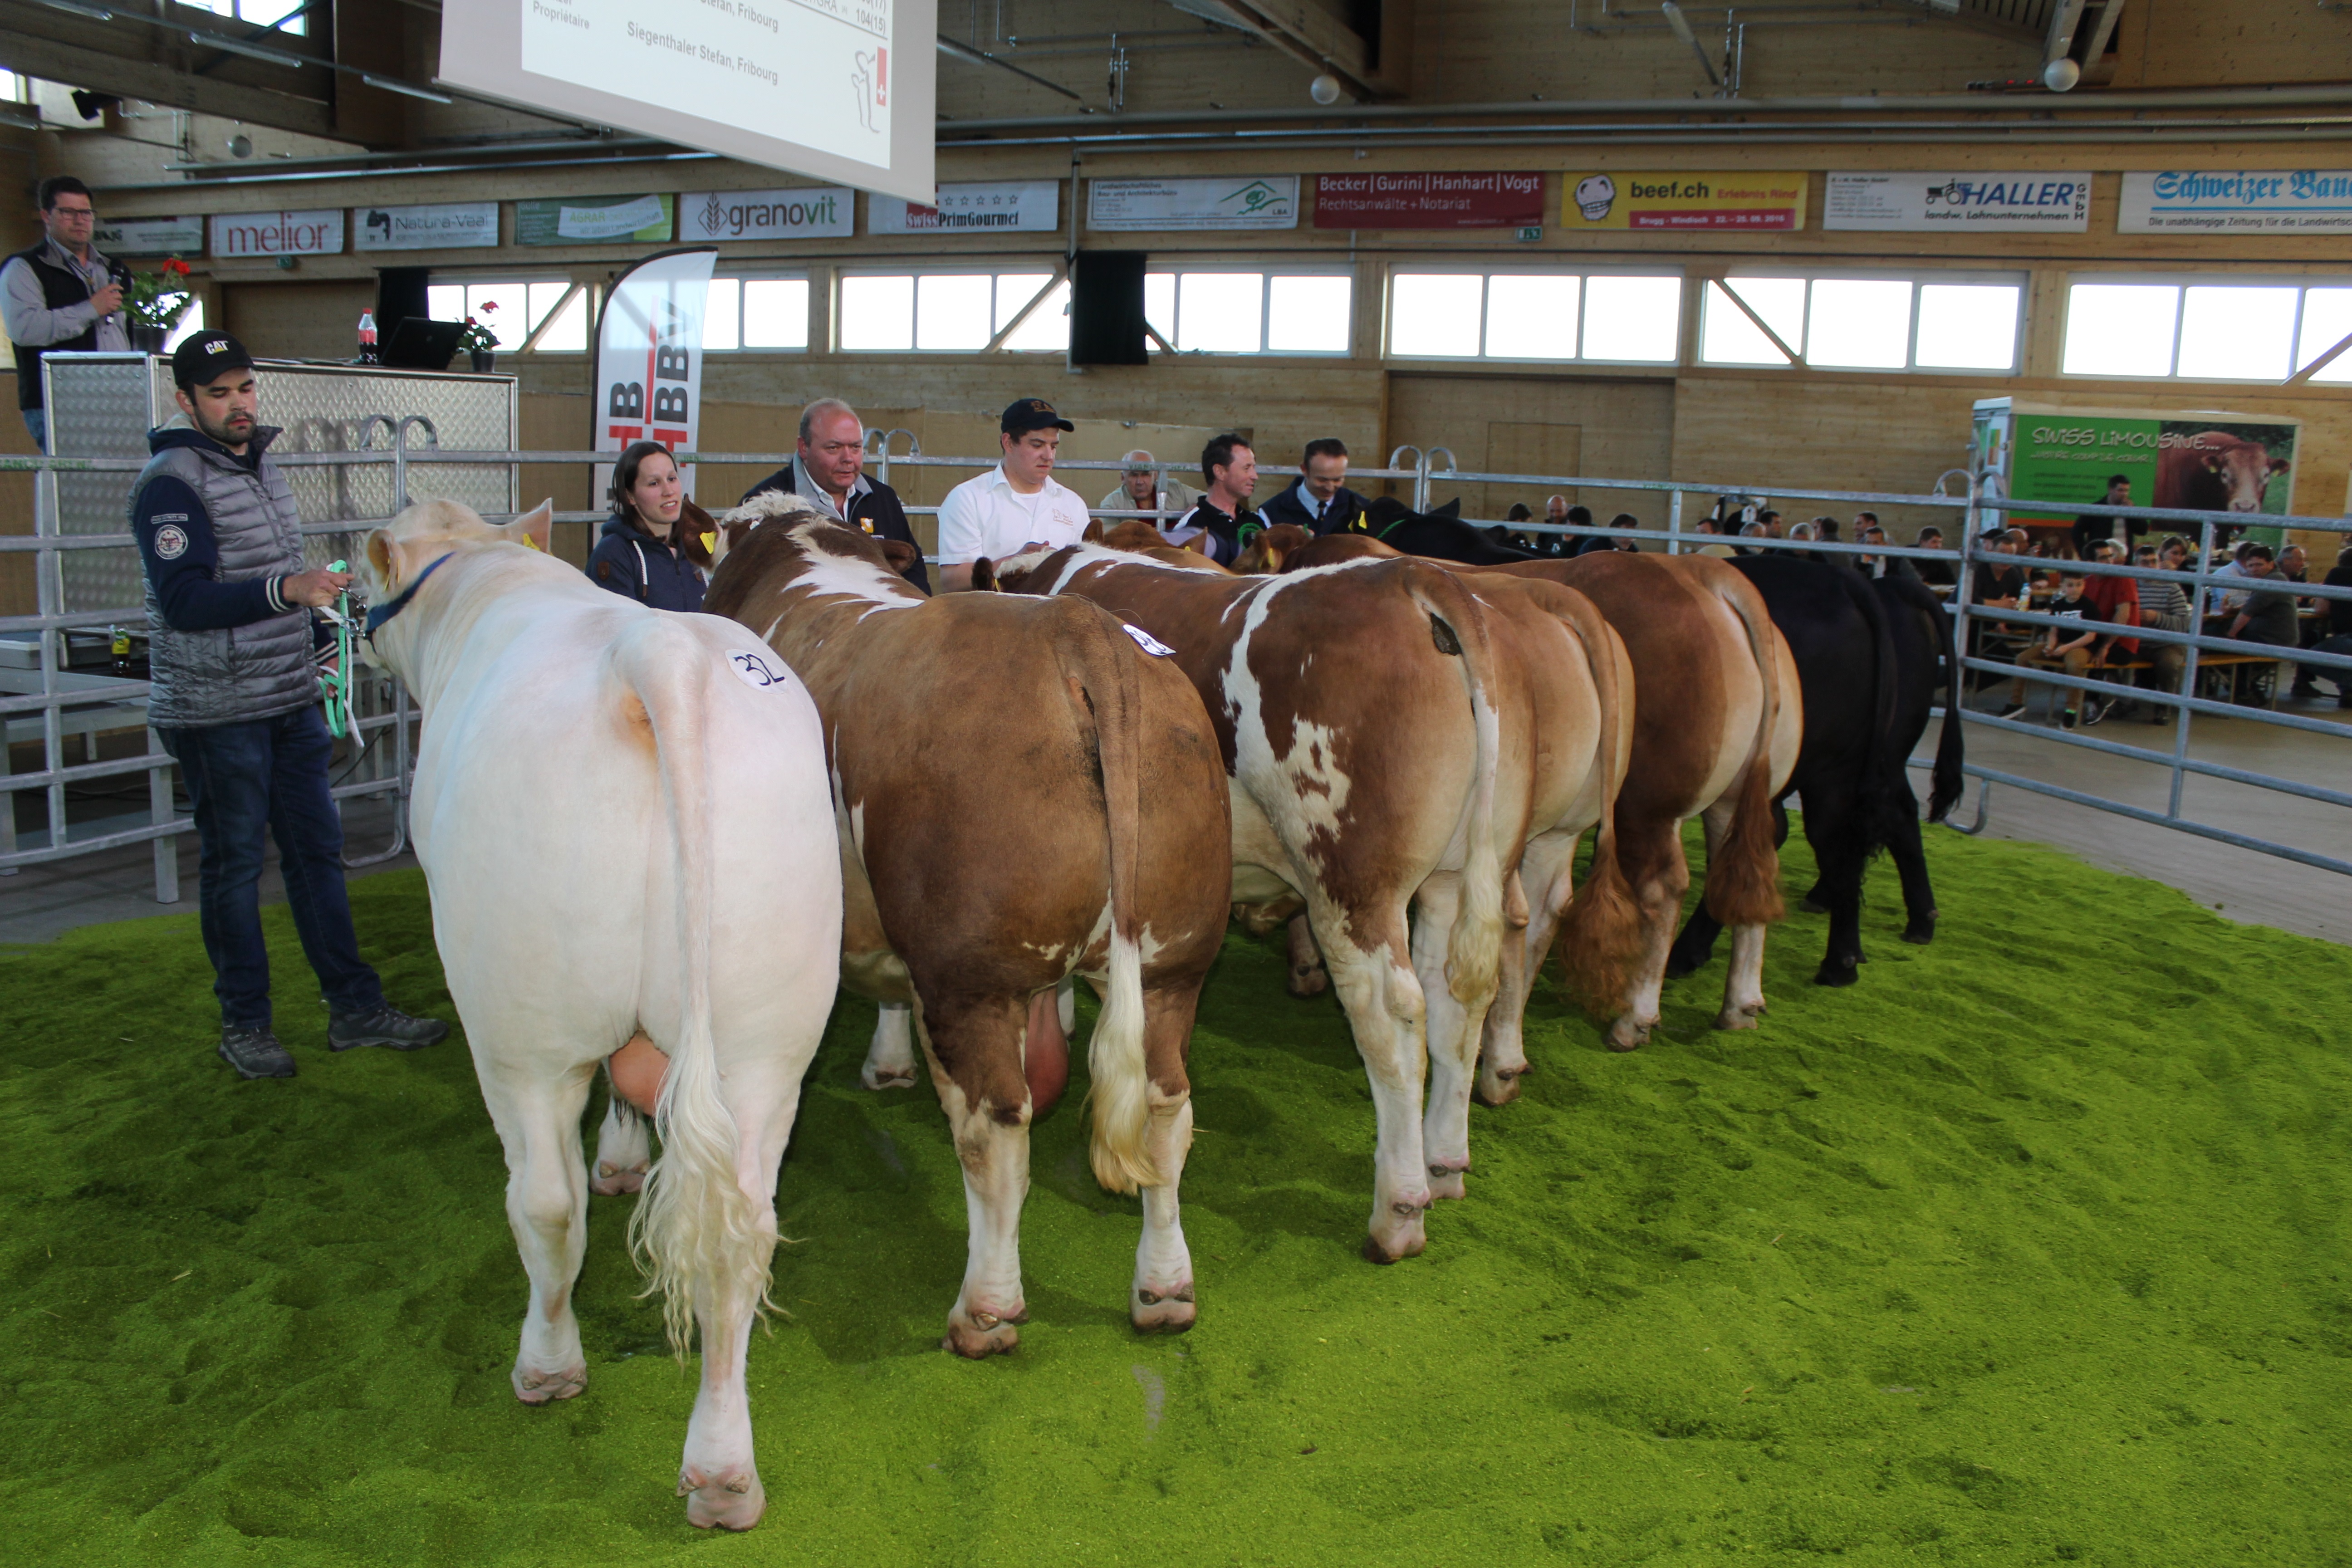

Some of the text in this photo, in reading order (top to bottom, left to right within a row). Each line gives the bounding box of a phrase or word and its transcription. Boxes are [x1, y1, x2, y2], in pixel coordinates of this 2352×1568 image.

[533, 1, 589, 29] Propriétaire
[738, 2, 778, 33] Fribourg
[856, 8, 885, 35] 104(15)
[627, 21, 778, 86] Siegenthaler Stefan, Fribourg
[1320, 174, 1539, 194] Becker Gurini Hanhart Vogt
[1631, 181, 1798, 199] beef.ch Erlebnis Rind
[1959, 182, 2075, 206] HALLER
[2153, 171, 2284, 204] Schweizer
[569, 211, 605, 222] AGRAR
[729, 196, 837, 235] granovit
[1319, 197, 1407, 211] Rechtsanwälte
[1420, 197, 1471, 211] Notariat
[1966, 210, 2069, 220] Lohnunternehmen
[228, 211, 329, 253] melior
[2149, 217, 2163, 226] Die
[2166, 217, 2225, 227] unabhängige
[2228, 217, 2262, 227] Zeitung
[2266, 217, 2279, 226] für
[2281, 217, 2296, 226] die
[204, 340, 229, 355] CAT
[733, 654, 785, 686] 32
